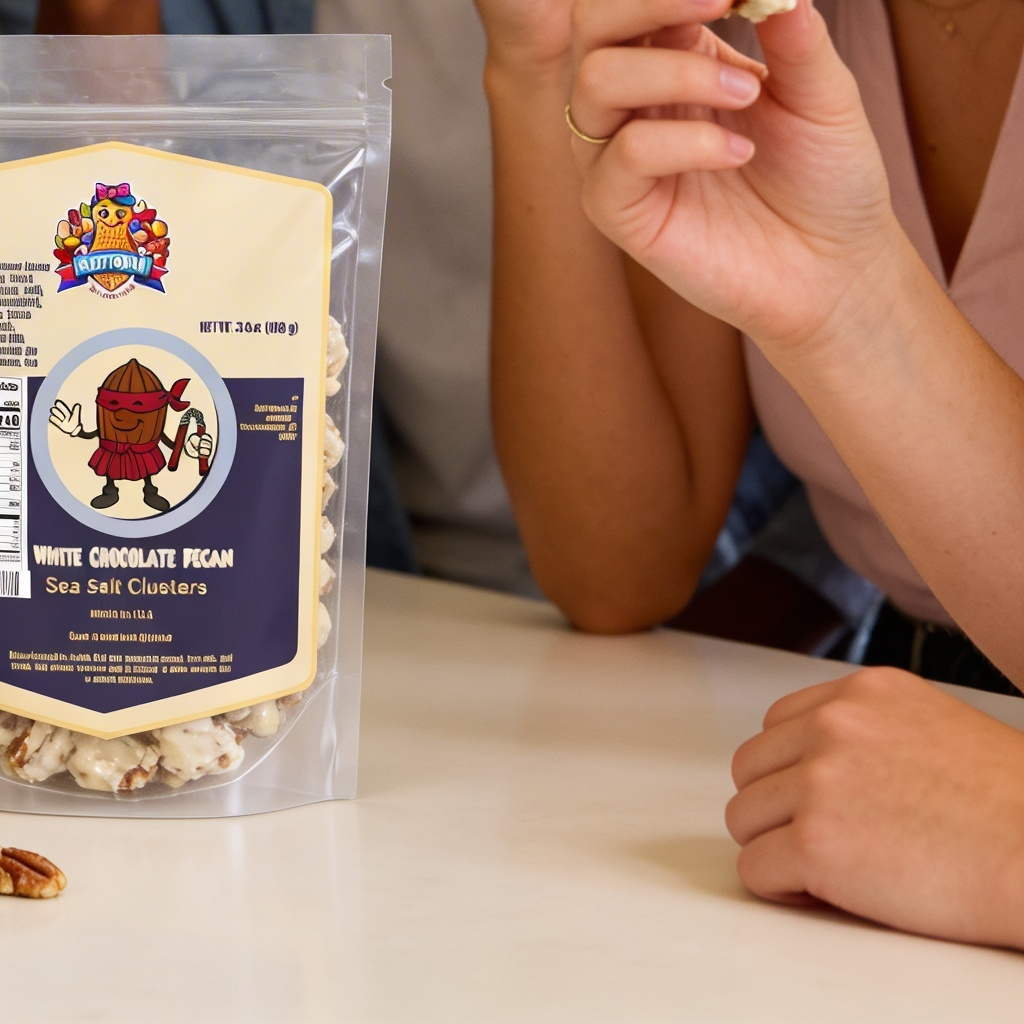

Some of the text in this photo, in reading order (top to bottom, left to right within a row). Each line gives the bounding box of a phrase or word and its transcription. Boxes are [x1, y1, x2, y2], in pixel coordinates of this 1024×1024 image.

[89, 546, 177, 568] CHOCOLATE
[182, 548, 234, 568] PECAN
[46, 576, 208, 595] Sea Salt Clusters
